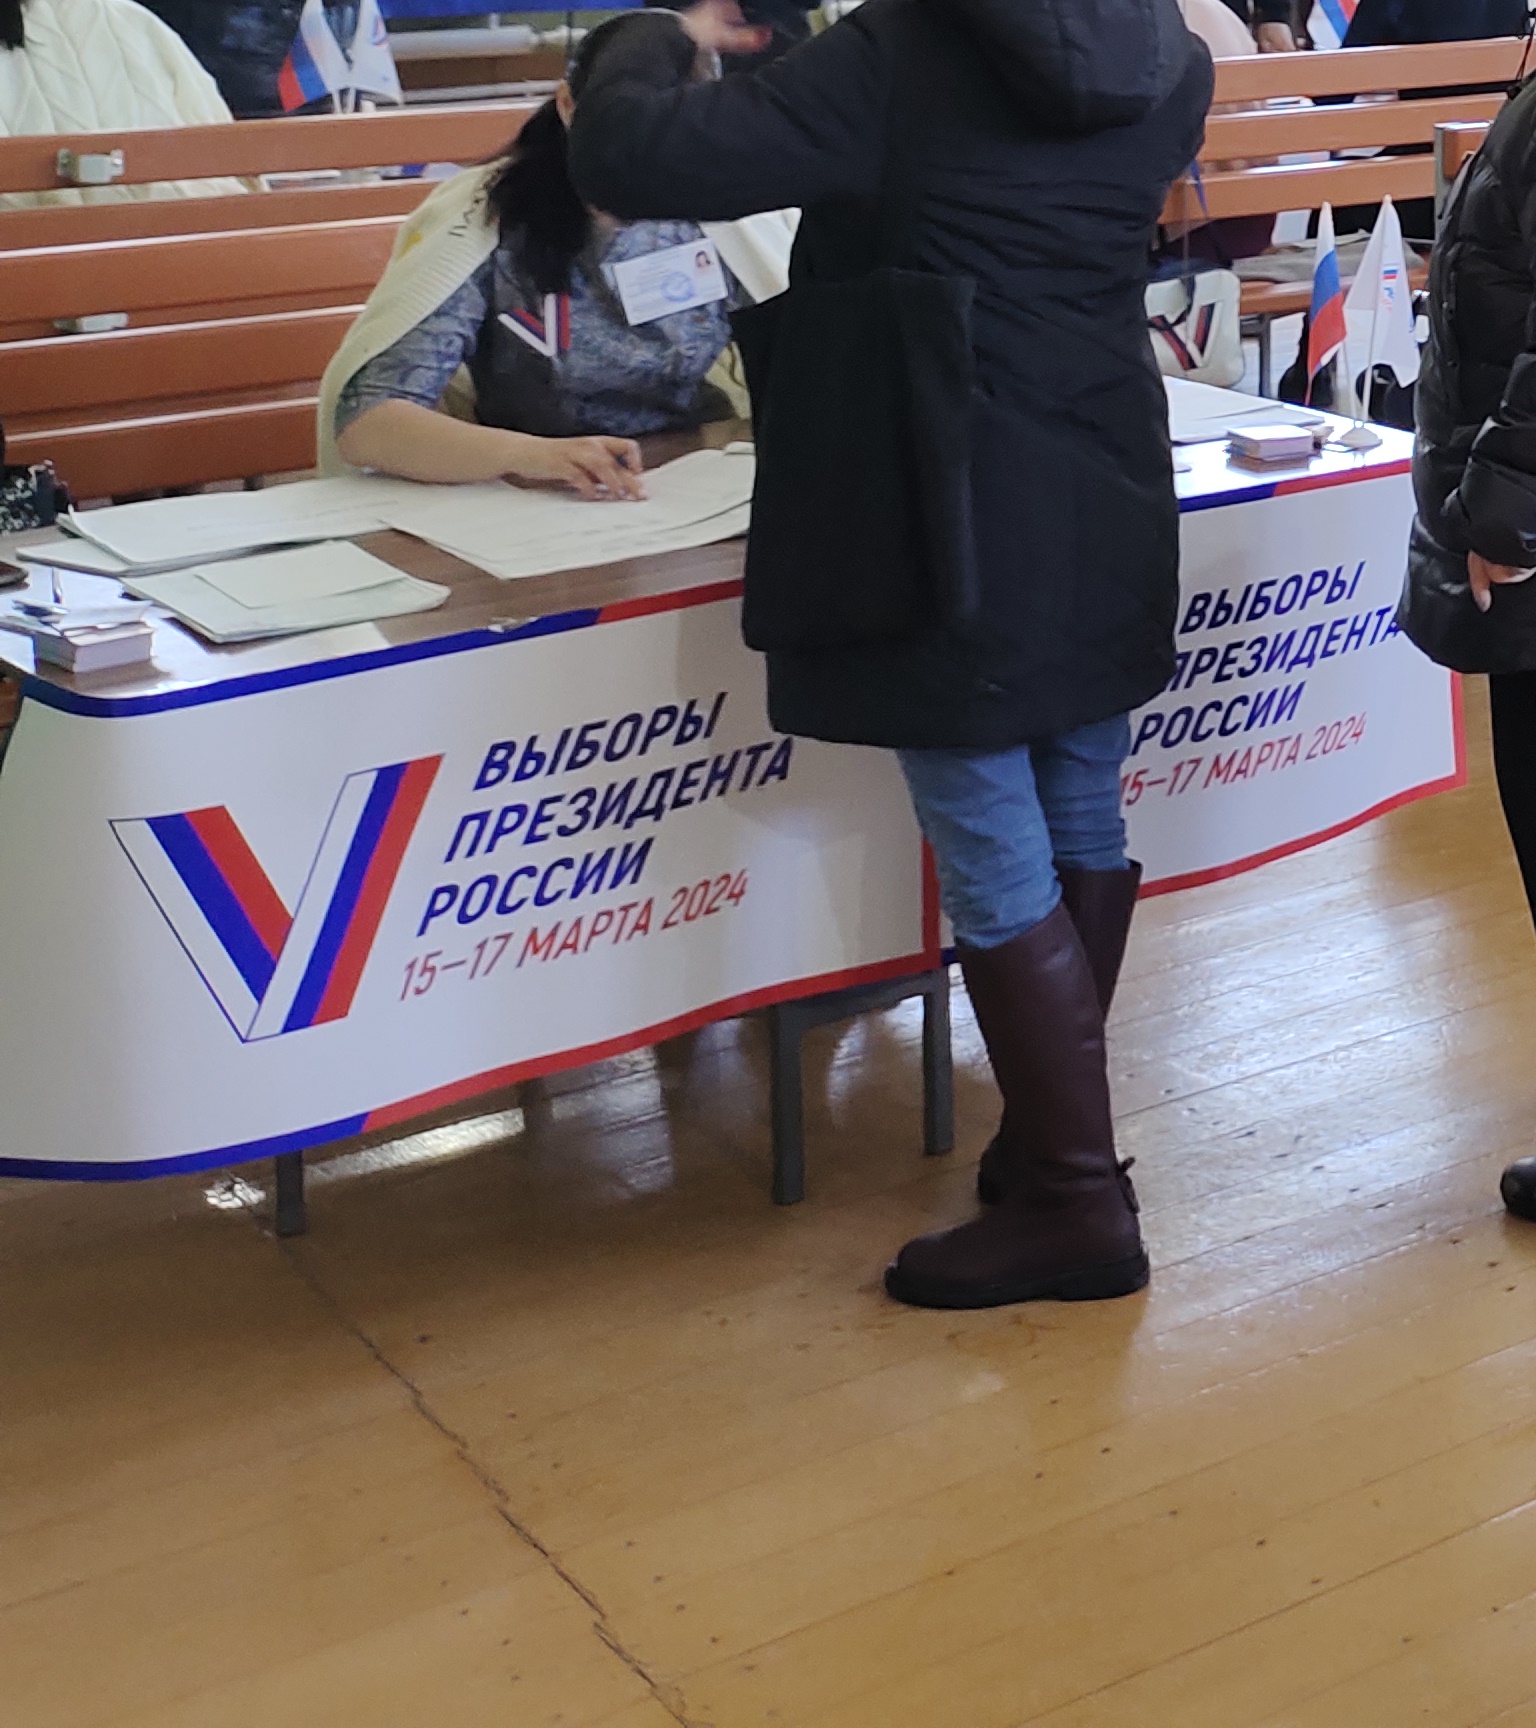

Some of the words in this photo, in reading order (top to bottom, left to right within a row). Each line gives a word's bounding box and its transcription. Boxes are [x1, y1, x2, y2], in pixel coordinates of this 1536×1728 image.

[1178, 560, 1366, 635] ВЫБОРЫ
[473, 692, 728, 791] ВЫБОРЫ
[1131, 680, 1306, 756] РОССИИ
[1203, 733, 1304, 789] МАРТА
[1304, 711, 1367, 761] 2024
[443, 737, 794, 863] ПРЕЗИДЕНТА
[416, 837, 655, 937] РОССИИ
[516, 898, 654, 968] МАРТА
[660, 869, 748, 930] 2024
